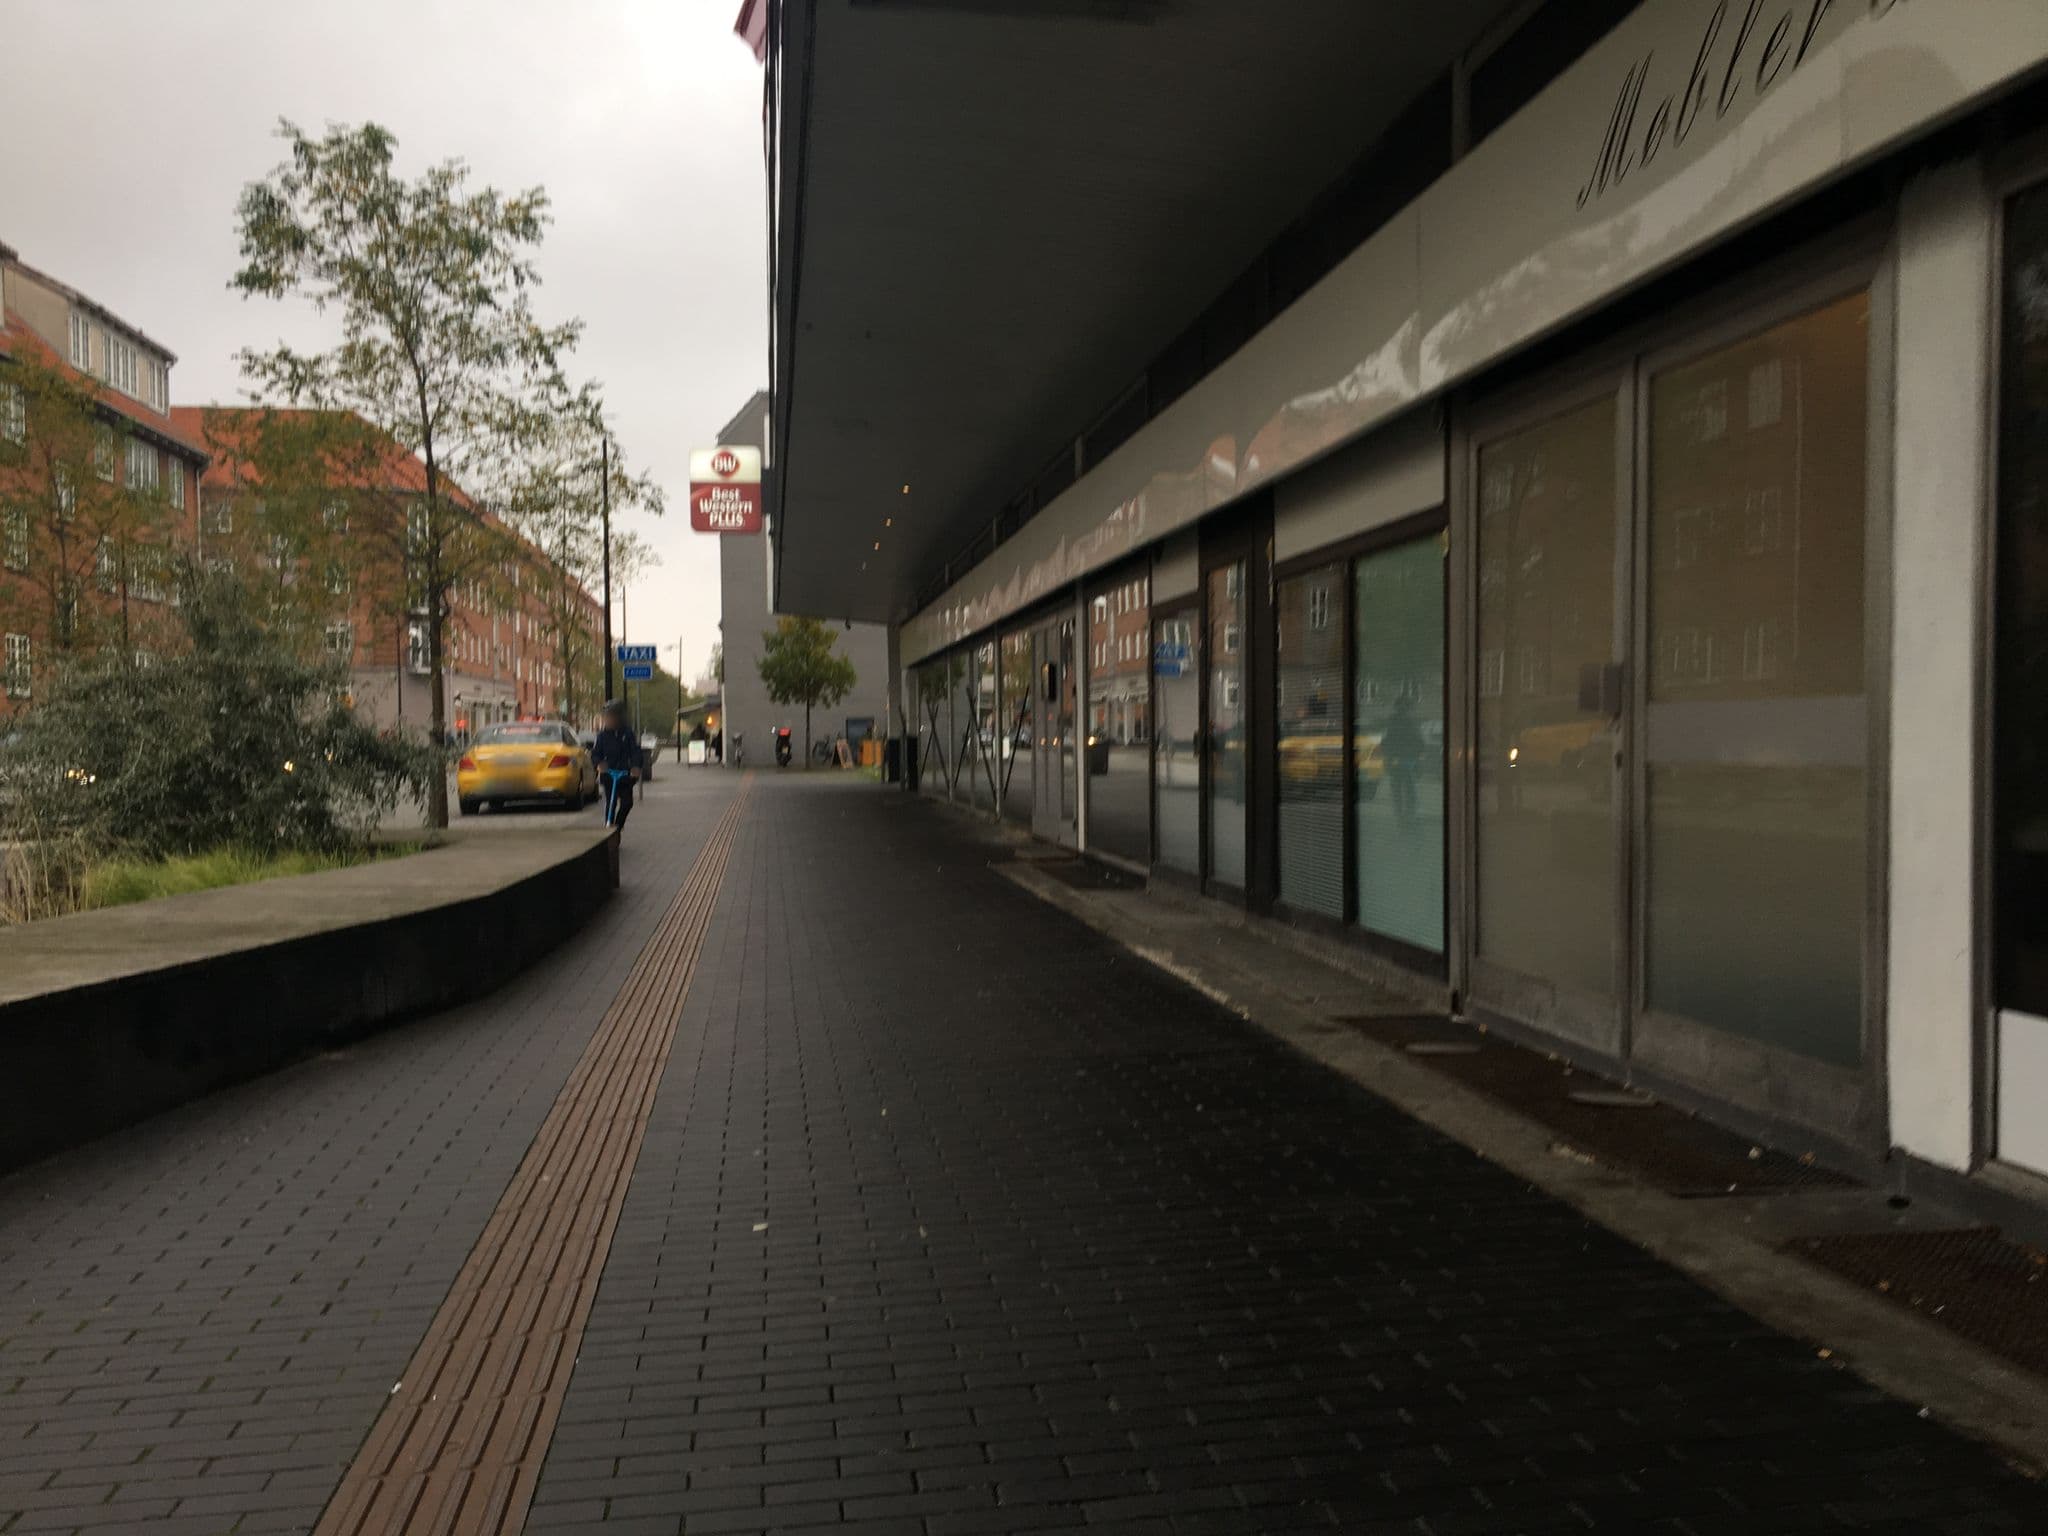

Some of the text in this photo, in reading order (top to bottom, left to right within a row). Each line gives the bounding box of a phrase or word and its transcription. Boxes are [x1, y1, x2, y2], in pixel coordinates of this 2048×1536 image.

[713, 455, 737, 473] BW
[712, 487, 741, 501] Best
[699, 497, 752, 514] Western
[709, 512, 744, 528] PLUS
[623, 647, 653, 660] TAXI
